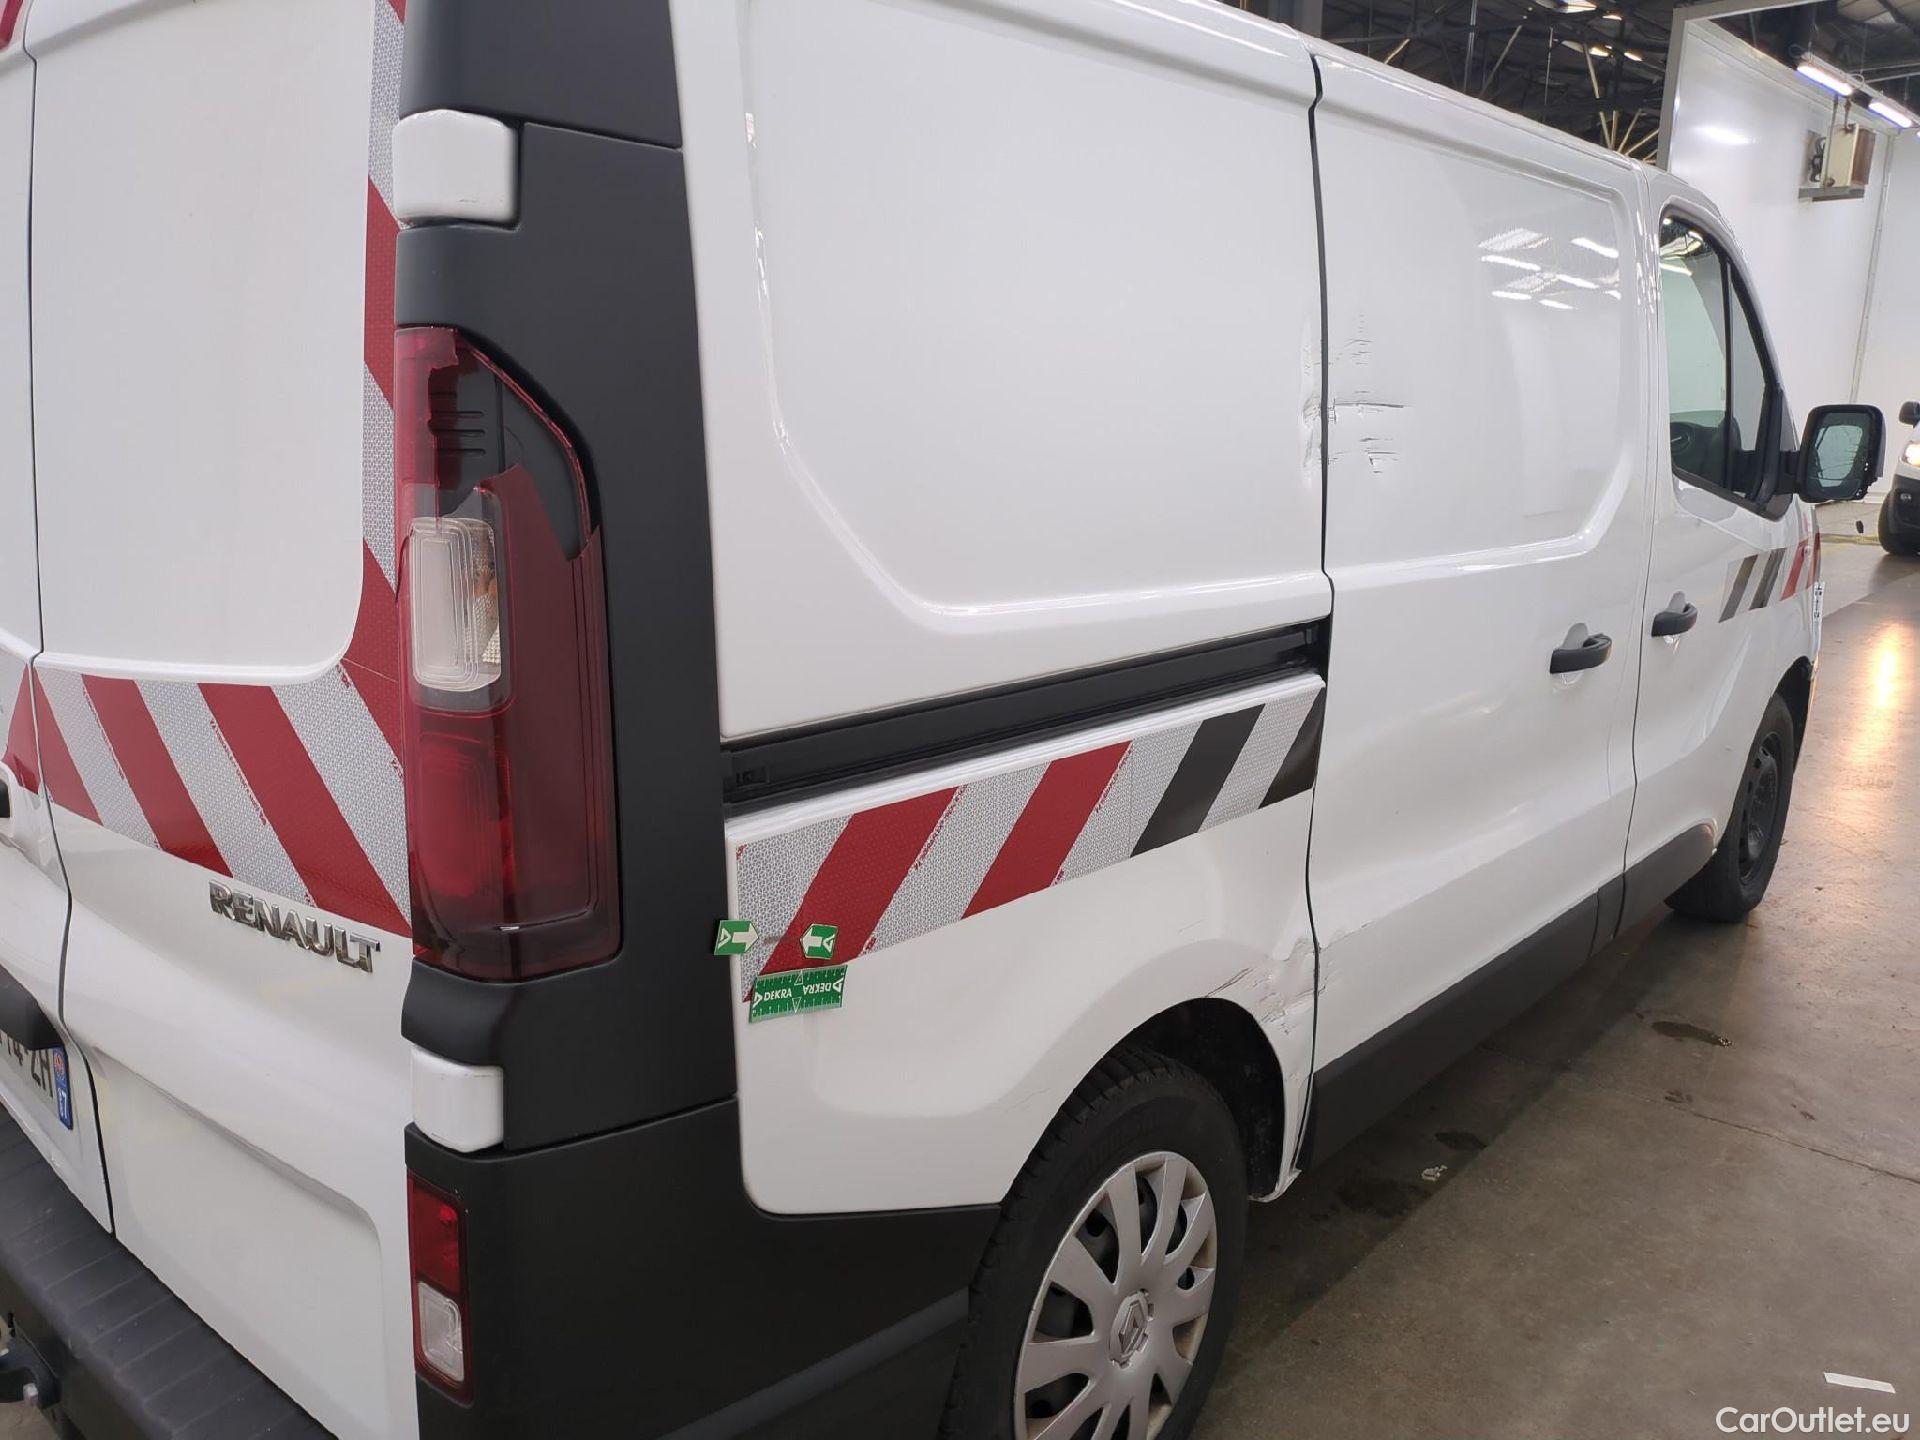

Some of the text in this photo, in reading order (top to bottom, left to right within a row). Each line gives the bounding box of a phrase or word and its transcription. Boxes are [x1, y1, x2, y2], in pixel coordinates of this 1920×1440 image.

[209, 879, 381, 973] RENAULT
[763, 988, 793, 1001] DEKRA
[802, 982, 832, 995] DEKRA
